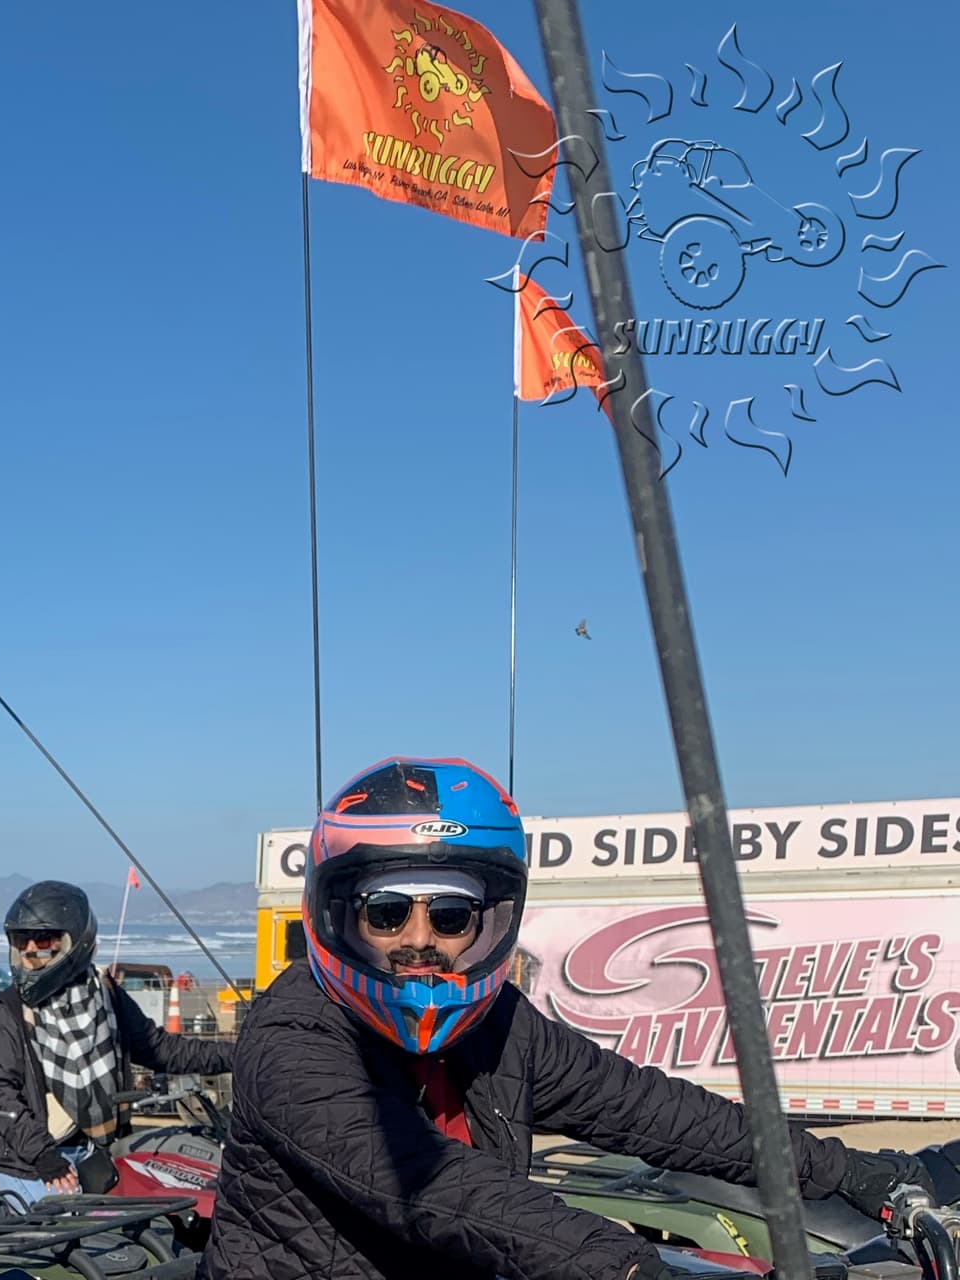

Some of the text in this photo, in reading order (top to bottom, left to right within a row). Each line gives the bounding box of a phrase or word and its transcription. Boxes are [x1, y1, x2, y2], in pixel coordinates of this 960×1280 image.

[362, 130, 496, 194] SUNBUGGY
[434, 189, 448, 201] CA
[420, 824, 458, 833] HJC
[732, 819, 802, 862] BY
[817, 812, 960, 859] SIDE
[615, 1006, 727, 1067] ATV
